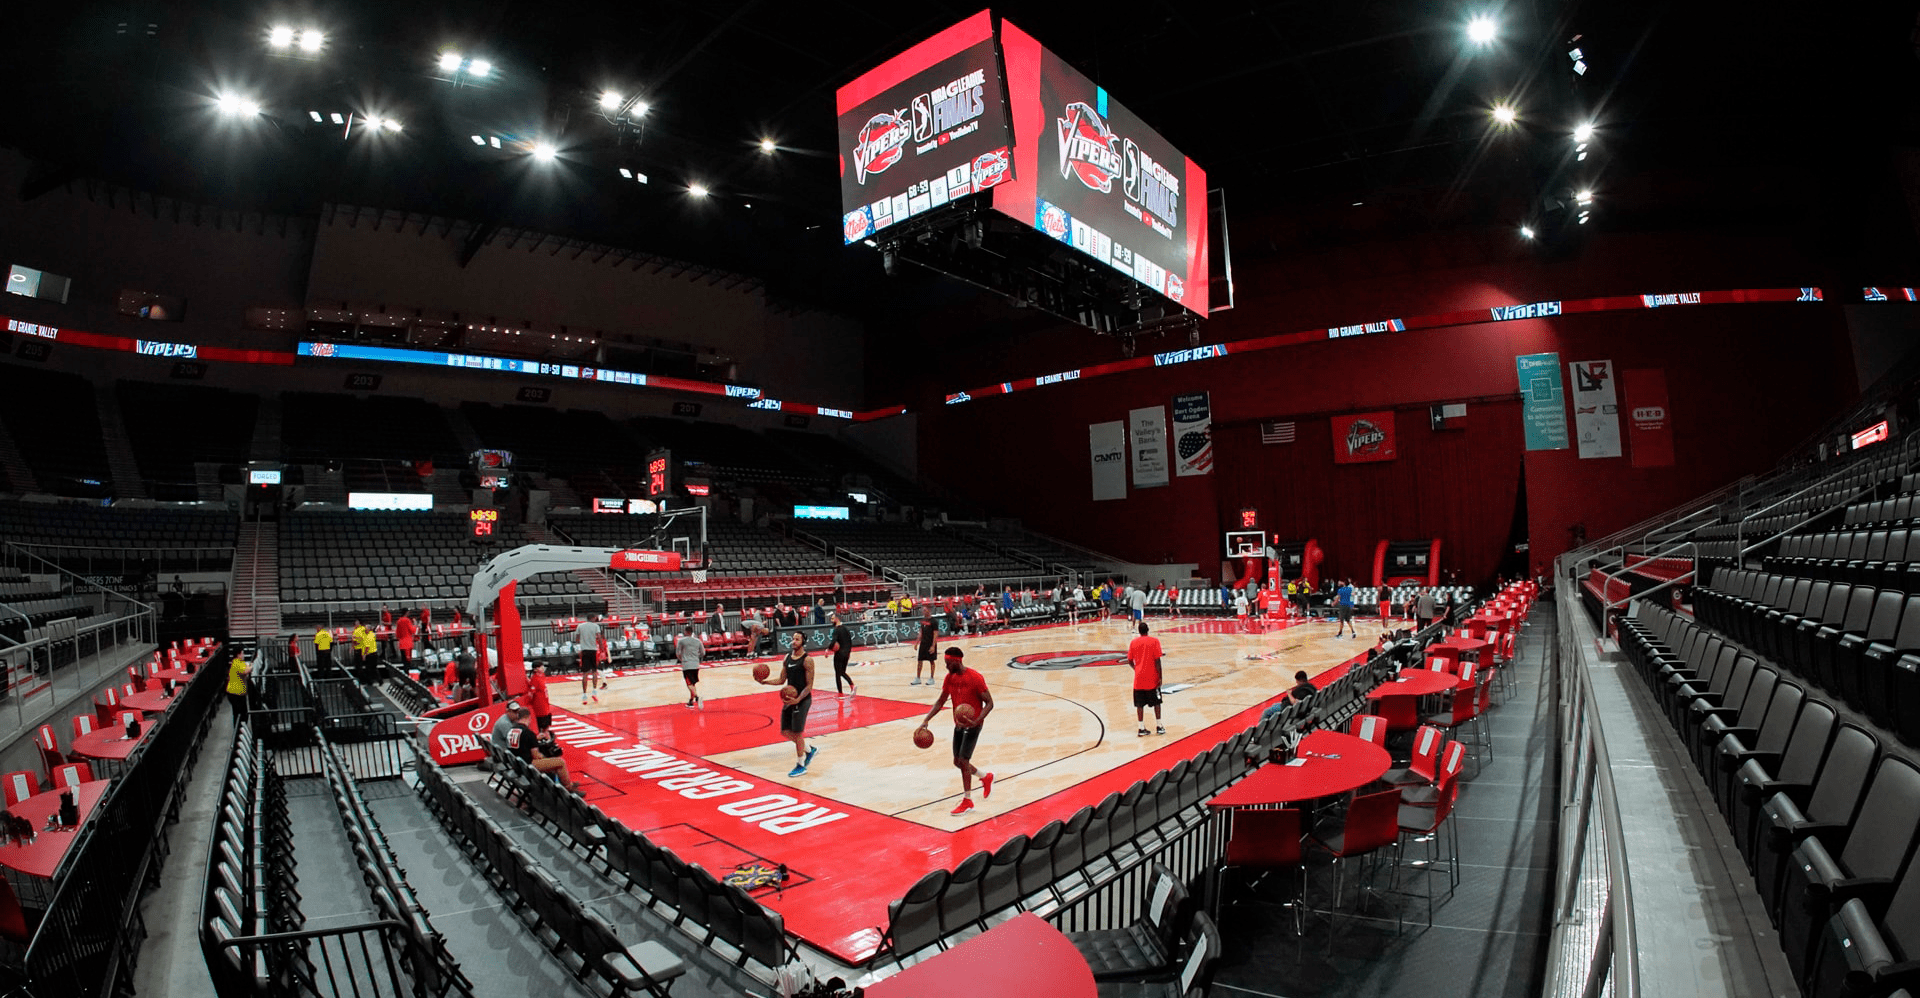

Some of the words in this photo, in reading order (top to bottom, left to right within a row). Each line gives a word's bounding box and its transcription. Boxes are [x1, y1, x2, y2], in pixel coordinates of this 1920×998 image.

[933, 85, 984, 135] FINALS
[853, 119, 911, 185] VIPERS
[1057, 111, 1122, 180] VIPERS
[971, 158, 1008, 194] VIPERS
[1140, 169, 1178, 229] FINALS
[1655, 294, 1679, 305] GRANDE
[1679, 292, 1700, 304] VALLEY
[18, 321, 38, 335] GRANDE
[38, 324, 58, 339] VALLEY
[1340, 324, 1364, 337] GRANDE
[1365, 321, 1388, 334] VALLEY
[25, 343, 43, 356] 205
[136, 340, 197, 359] VIPERS
[353, 375, 374, 386] 203
[524, 388, 544, 399] 202
[1177, 395, 1203, 404] Welcome
[679, 403, 696, 413] 201
[1188, 406, 1208, 415] Ogden
[1182, 413, 1201, 421] Arena
[1134, 428, 1161, 438] Valley's
[1346, 423, 1385, 456] VIPERS
[1094, 452, 1122, 463] CANTU
[650, 473, 665, 495] 24
[475, 521, 492, 535] 24
[105, 575, 124, 584] ZONE
[587, 744, 755, 799] GRANDE
[717, 793, 850, 835] RIO
